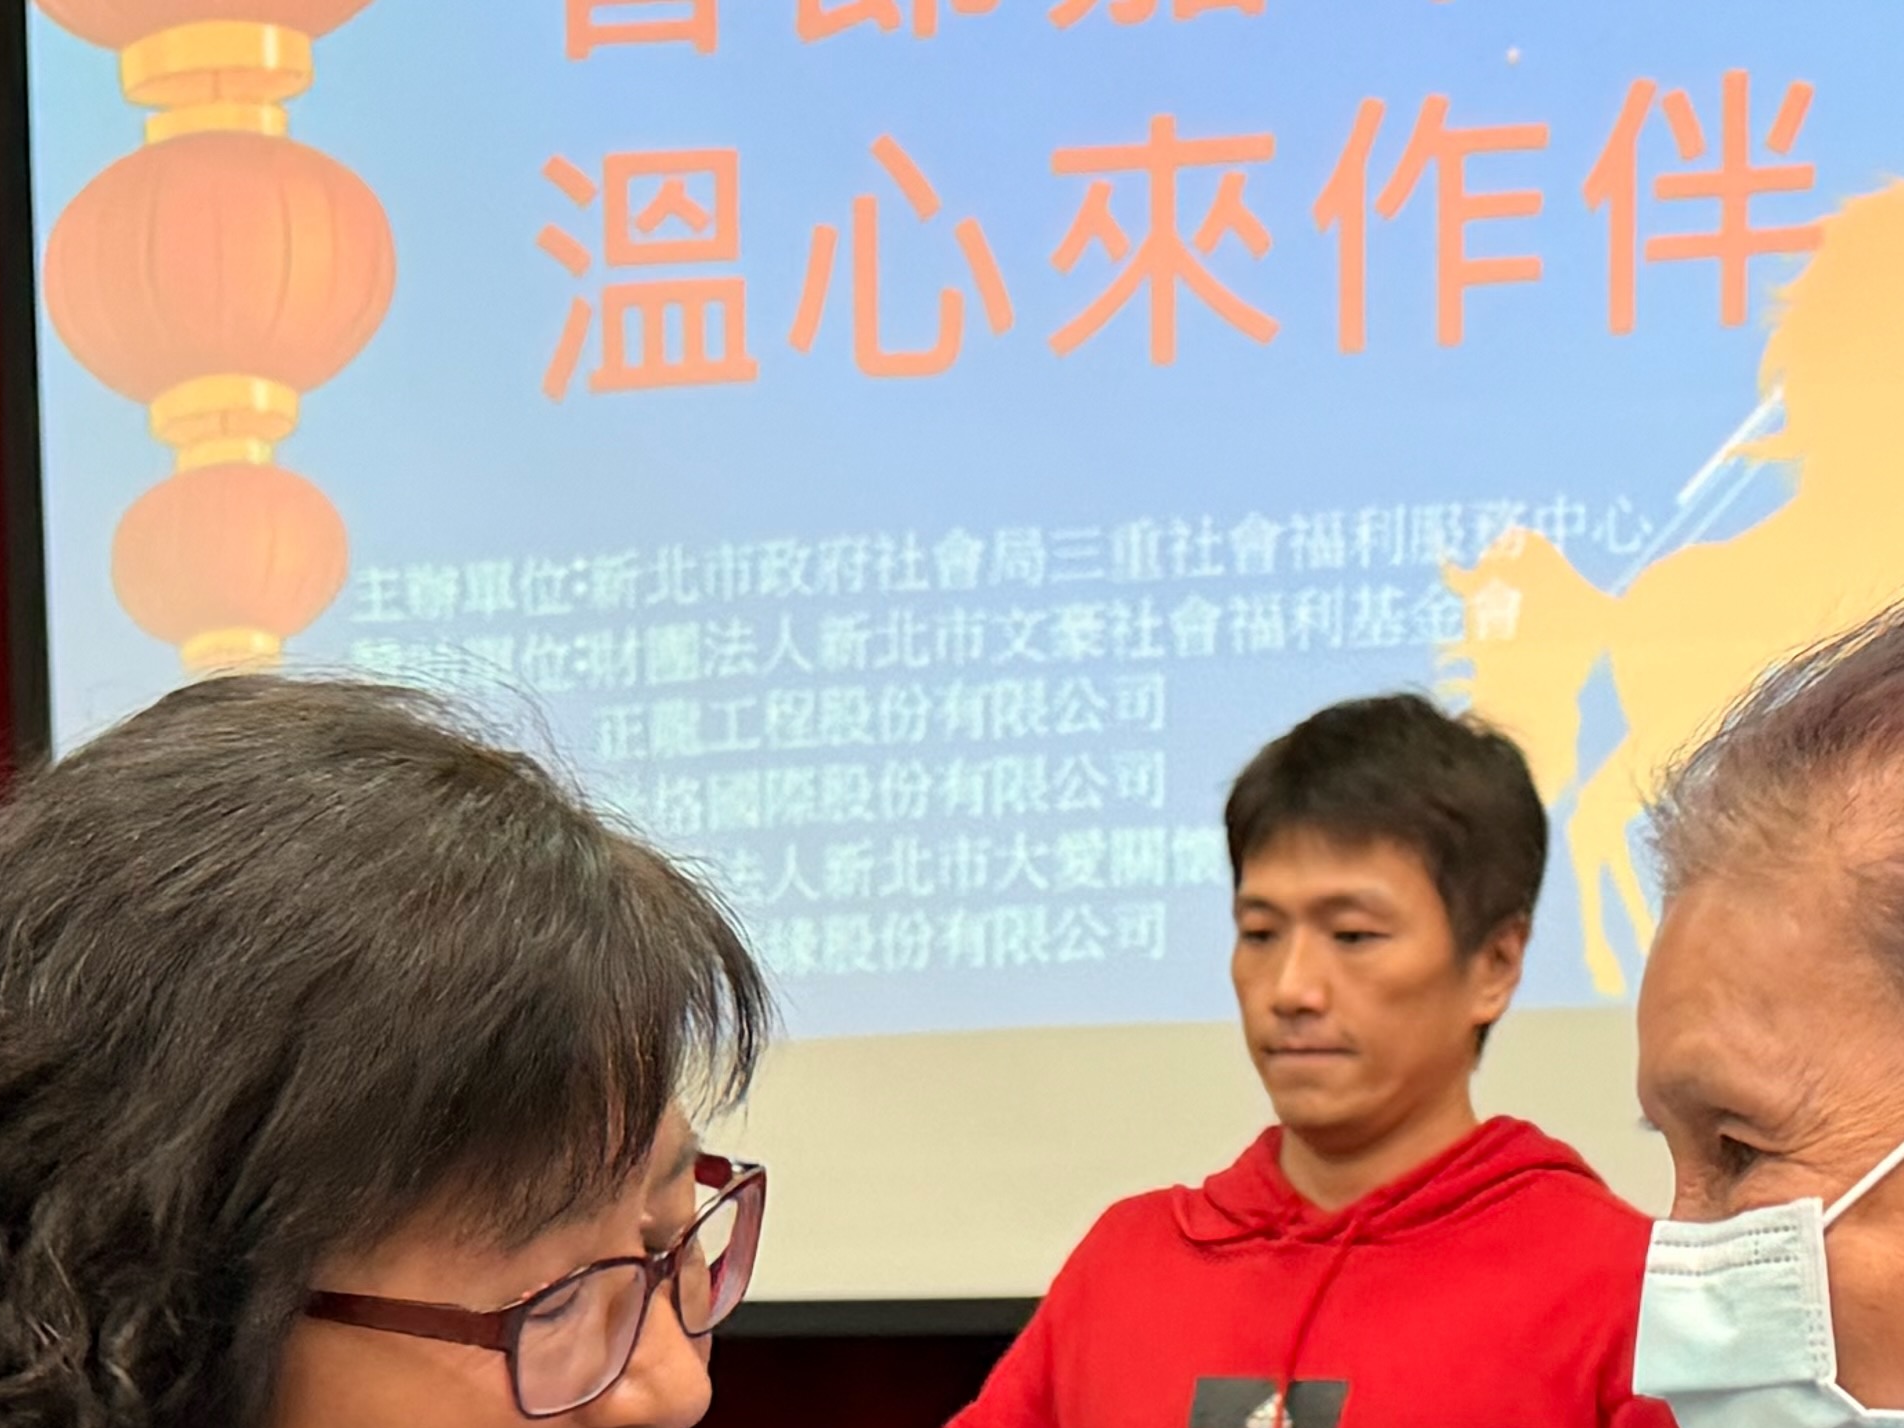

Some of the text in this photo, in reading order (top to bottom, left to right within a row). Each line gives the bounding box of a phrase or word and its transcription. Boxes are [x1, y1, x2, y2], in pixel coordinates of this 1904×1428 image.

[537, 69, 1827, 402] 溫心來作伴
